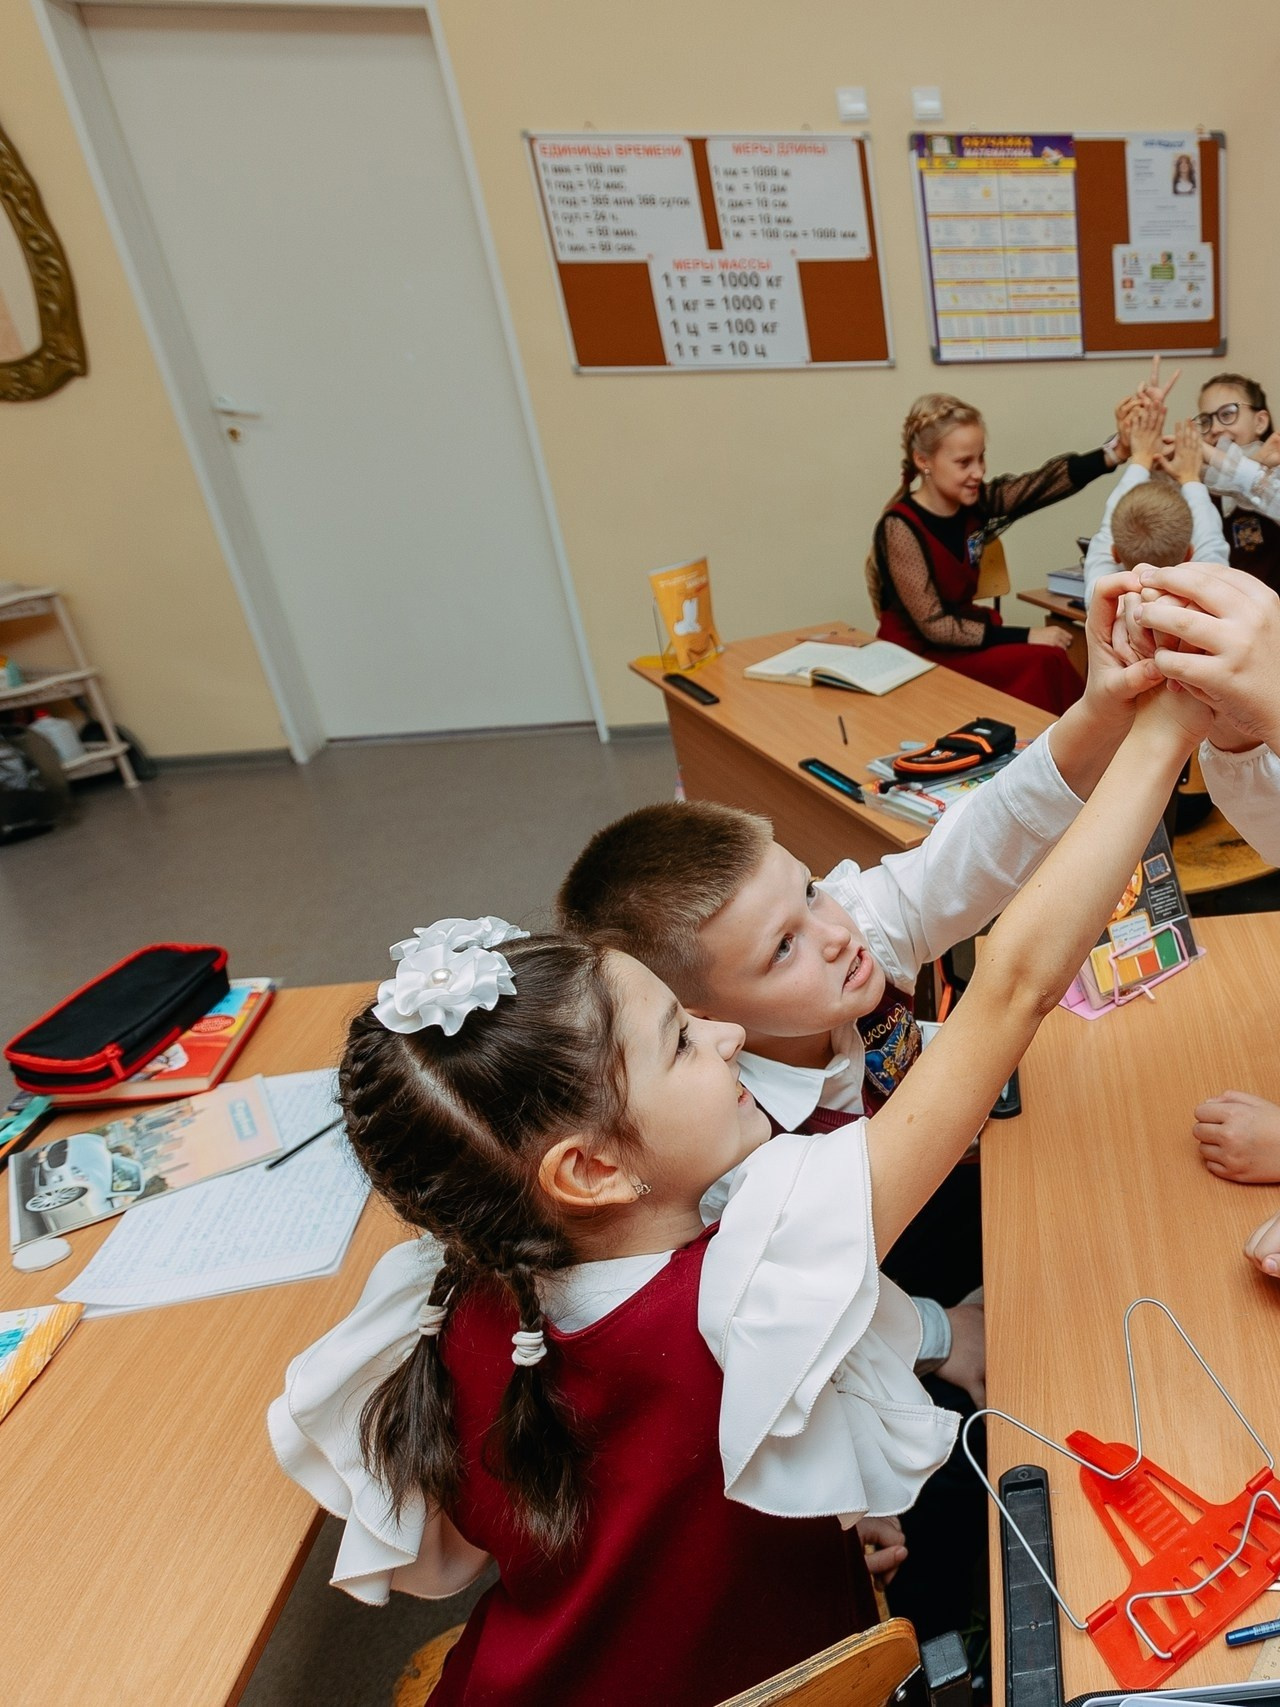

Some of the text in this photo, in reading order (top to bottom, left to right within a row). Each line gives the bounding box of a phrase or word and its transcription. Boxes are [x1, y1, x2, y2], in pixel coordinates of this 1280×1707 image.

[616, 144, 682, 157] ВРЕМЕНИ
[733, 144, 773, 155] МЕРЫ
[752, 166, 777, 177] 1000
[755, 183, 766, 193] 10
[757, 198, 768, 208] 10
[759, 214, 770, 224] 10
[761, 228, 779, 239] 100
[812, 228, 836, 239] 1000
[673, 259, 771, 271] МЕРЫ МАССЫ
[663, 272, 671, 287] 1
[719, 271, 760, 287] 1000
[766, 276, 783, 287] кг
[667, 297, 676, 311] 1
[682, 300, 699, 311] кг
[722, 295, 764, 311] 1000
[671, 320, 680, 334] 1
[686, 324, 699, 337] ц
[725, 318, 756, 334] 100
[761, 323, 778, 334] кг
[675, 343, 684, 357] 1
[728, 341, 748, 356] 10
[754, 347, 768, 358] ц
